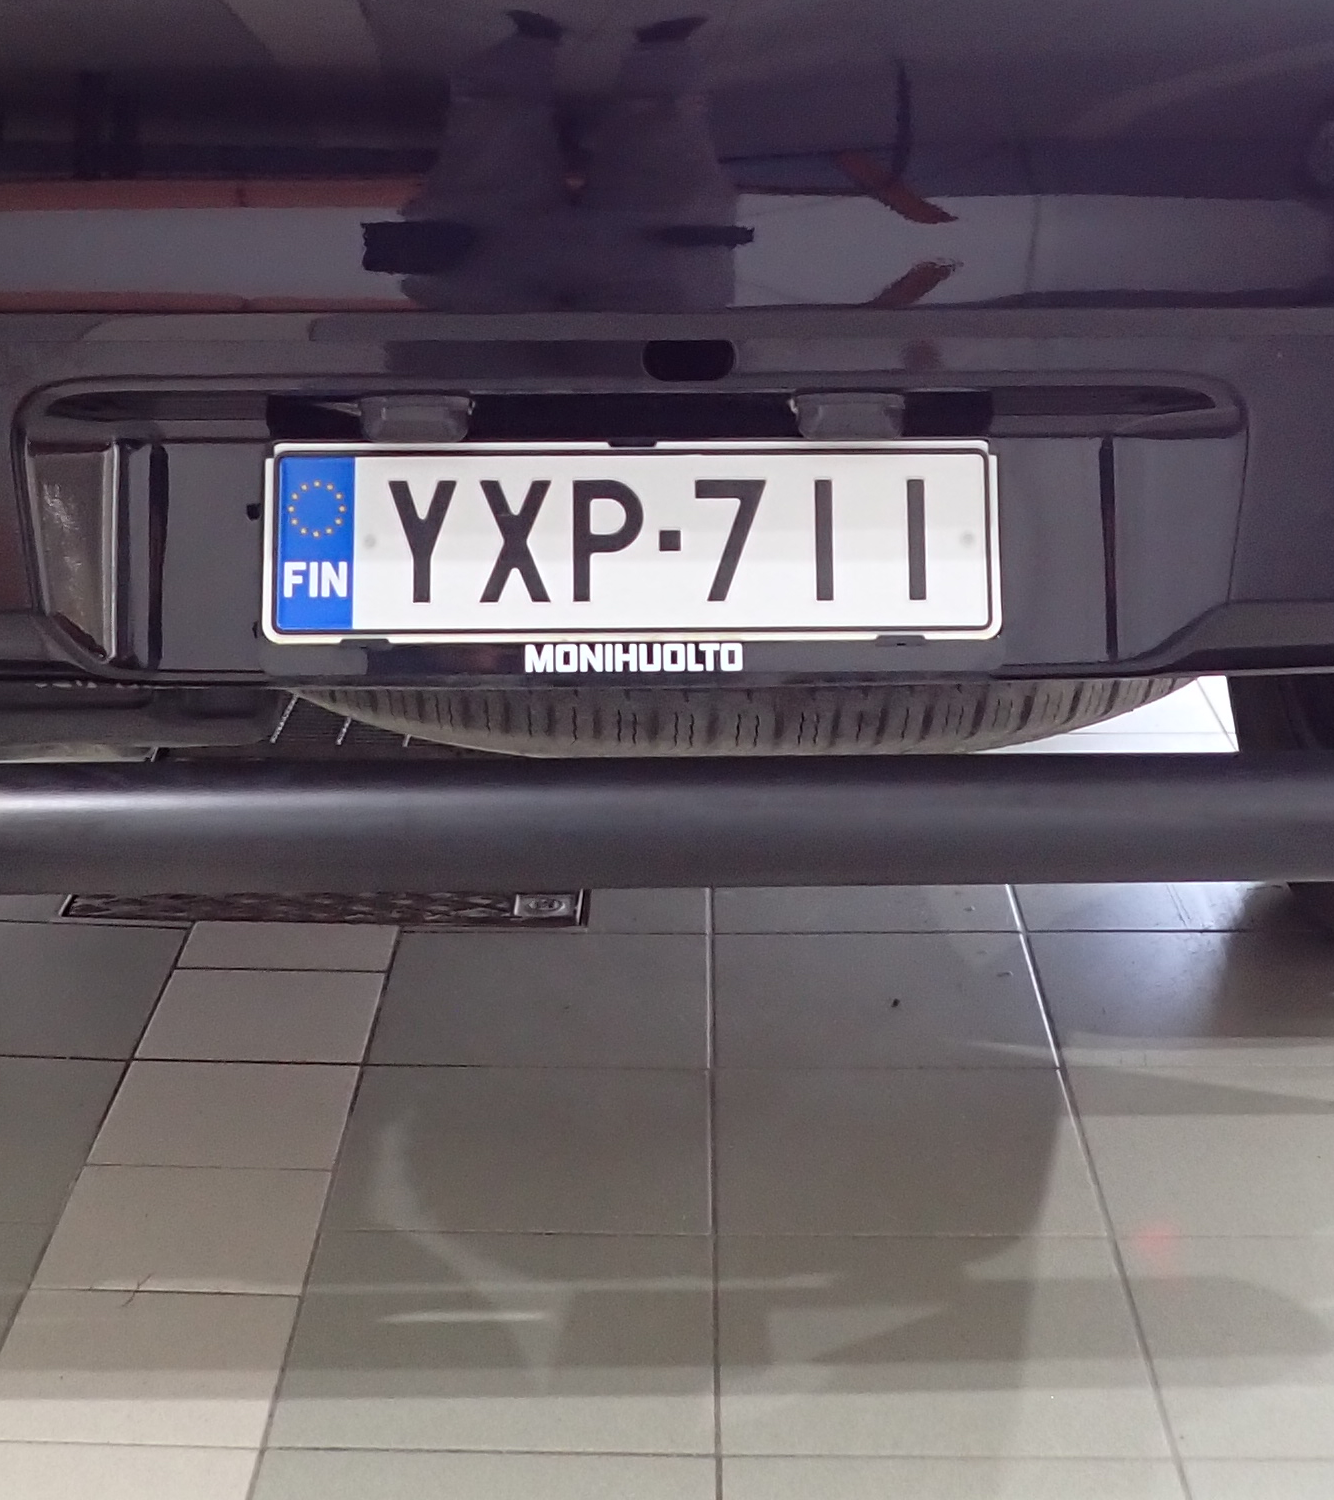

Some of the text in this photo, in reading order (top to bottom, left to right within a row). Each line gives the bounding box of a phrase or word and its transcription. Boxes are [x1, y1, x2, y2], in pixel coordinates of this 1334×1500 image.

[388, 478, 928, 604] YXP-711
[283, 562, 349, 598] FIN
[524, 642, 744, 673] MONIHUOLTO
